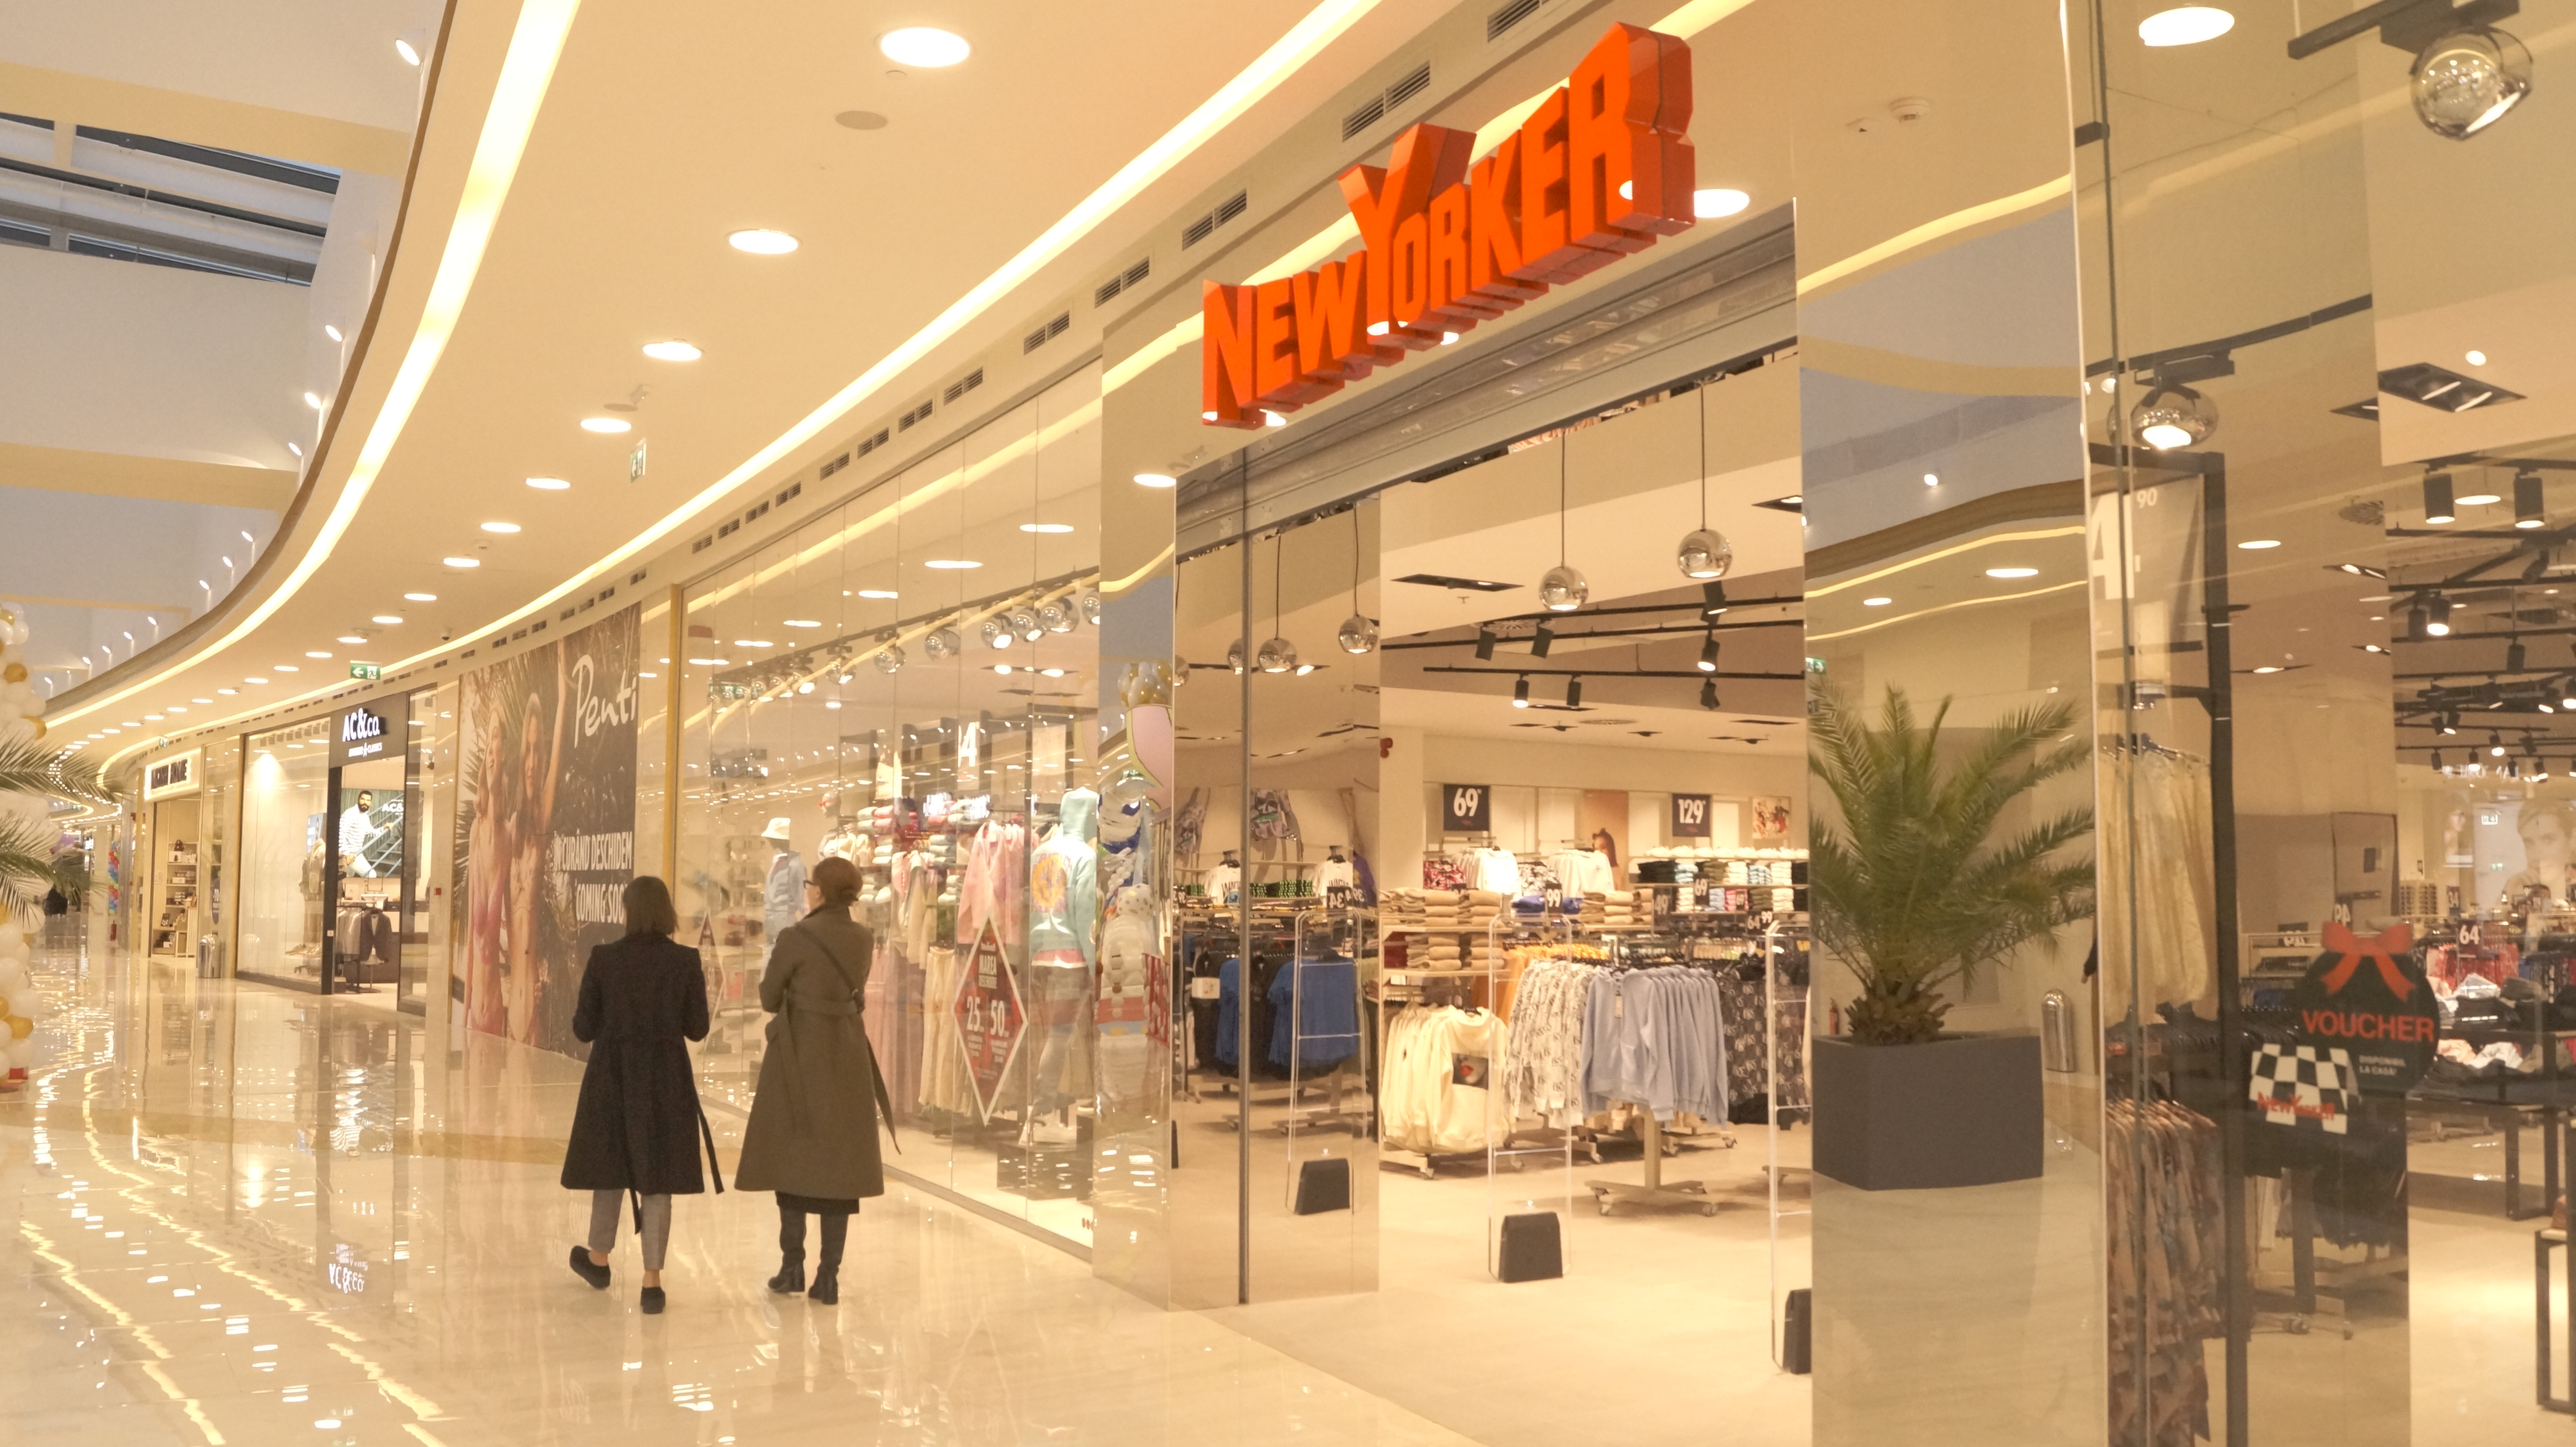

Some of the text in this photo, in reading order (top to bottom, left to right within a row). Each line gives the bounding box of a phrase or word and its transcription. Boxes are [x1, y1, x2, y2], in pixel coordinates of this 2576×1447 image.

[572, 654, 637, 748] Penti
[562, 828, 591, 871] CURÂND
[591, 831, 632, 871] DESCHIDEM
[576, 883, 627, 925] COMING SOO
[1547, 888, 1561, 908] 99
[2459, 924, 2480, 945] 64
[2302, 1009, 2435, 1043] VOUCHER
